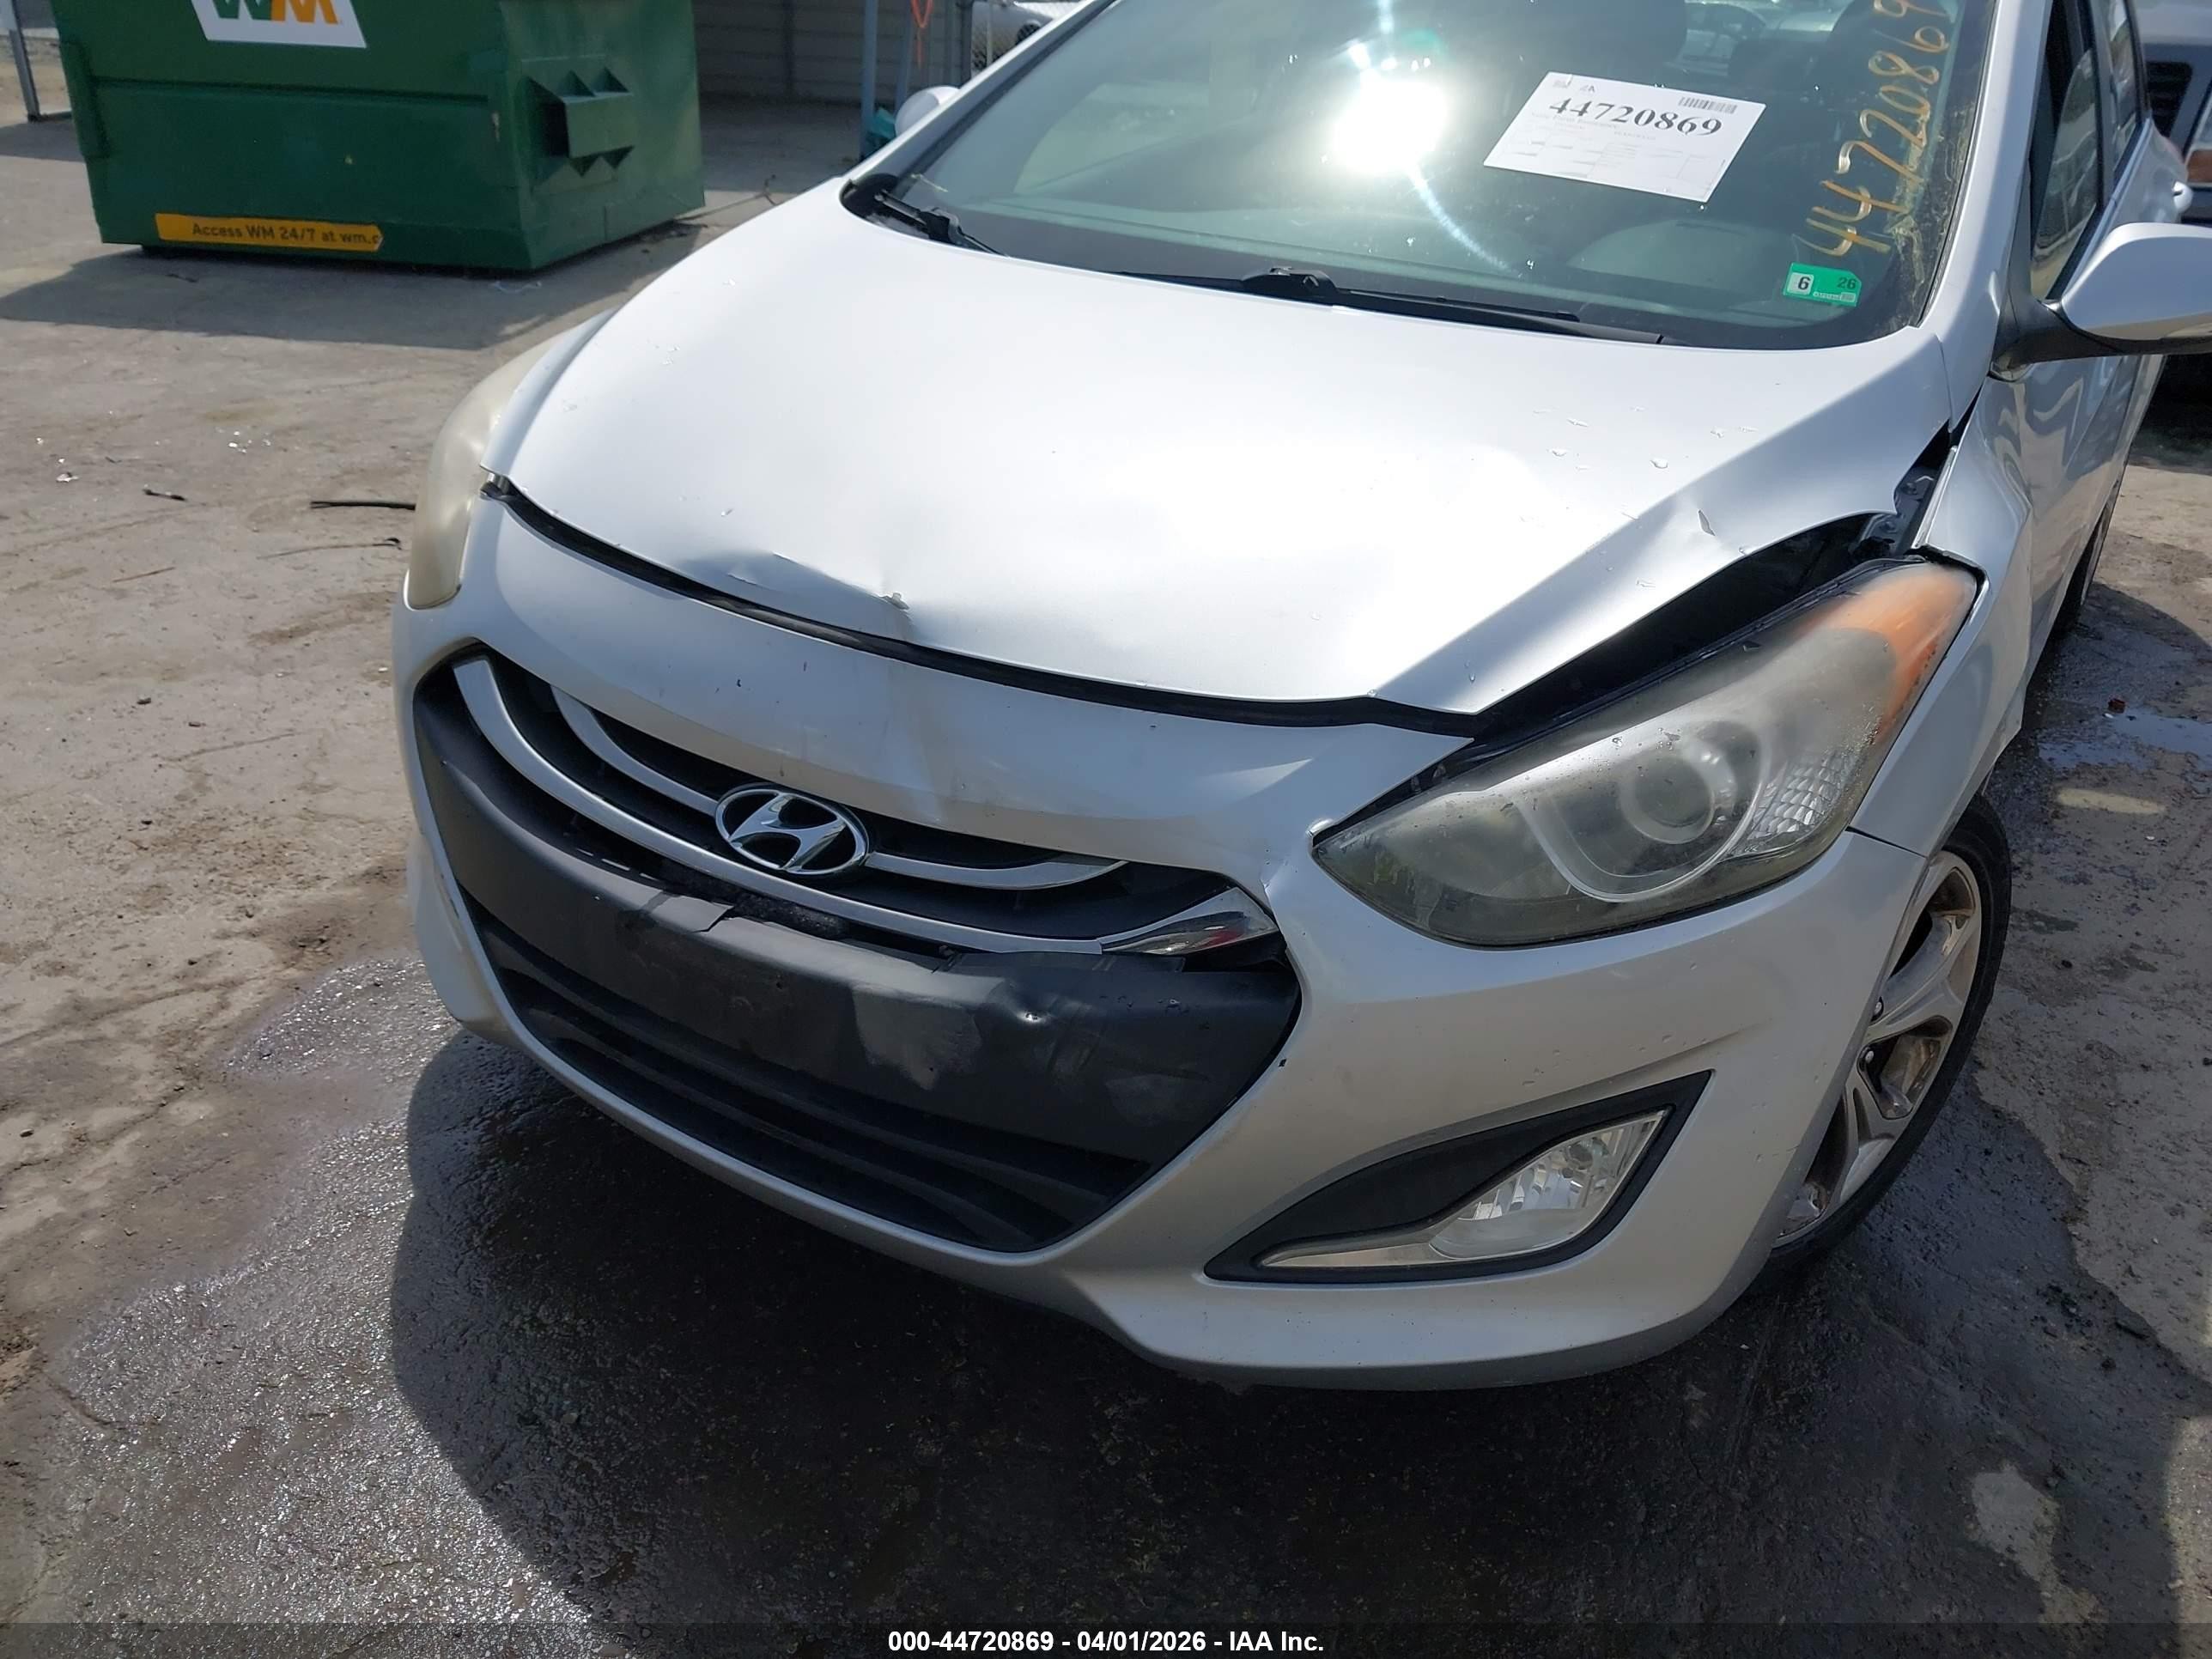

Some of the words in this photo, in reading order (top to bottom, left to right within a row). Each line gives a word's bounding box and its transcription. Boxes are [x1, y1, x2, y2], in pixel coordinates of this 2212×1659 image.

[1548, 97, 1723, 137] 44720869
[191, 223, 243, 239] Access
[246, 225, 276, 240] WM
[280, 227, 316, 241] 24/7
[321, 230, 337, 243] at
[1797, 276, 1811, 290] 6
[1837, 276, 1856, 290] 26
